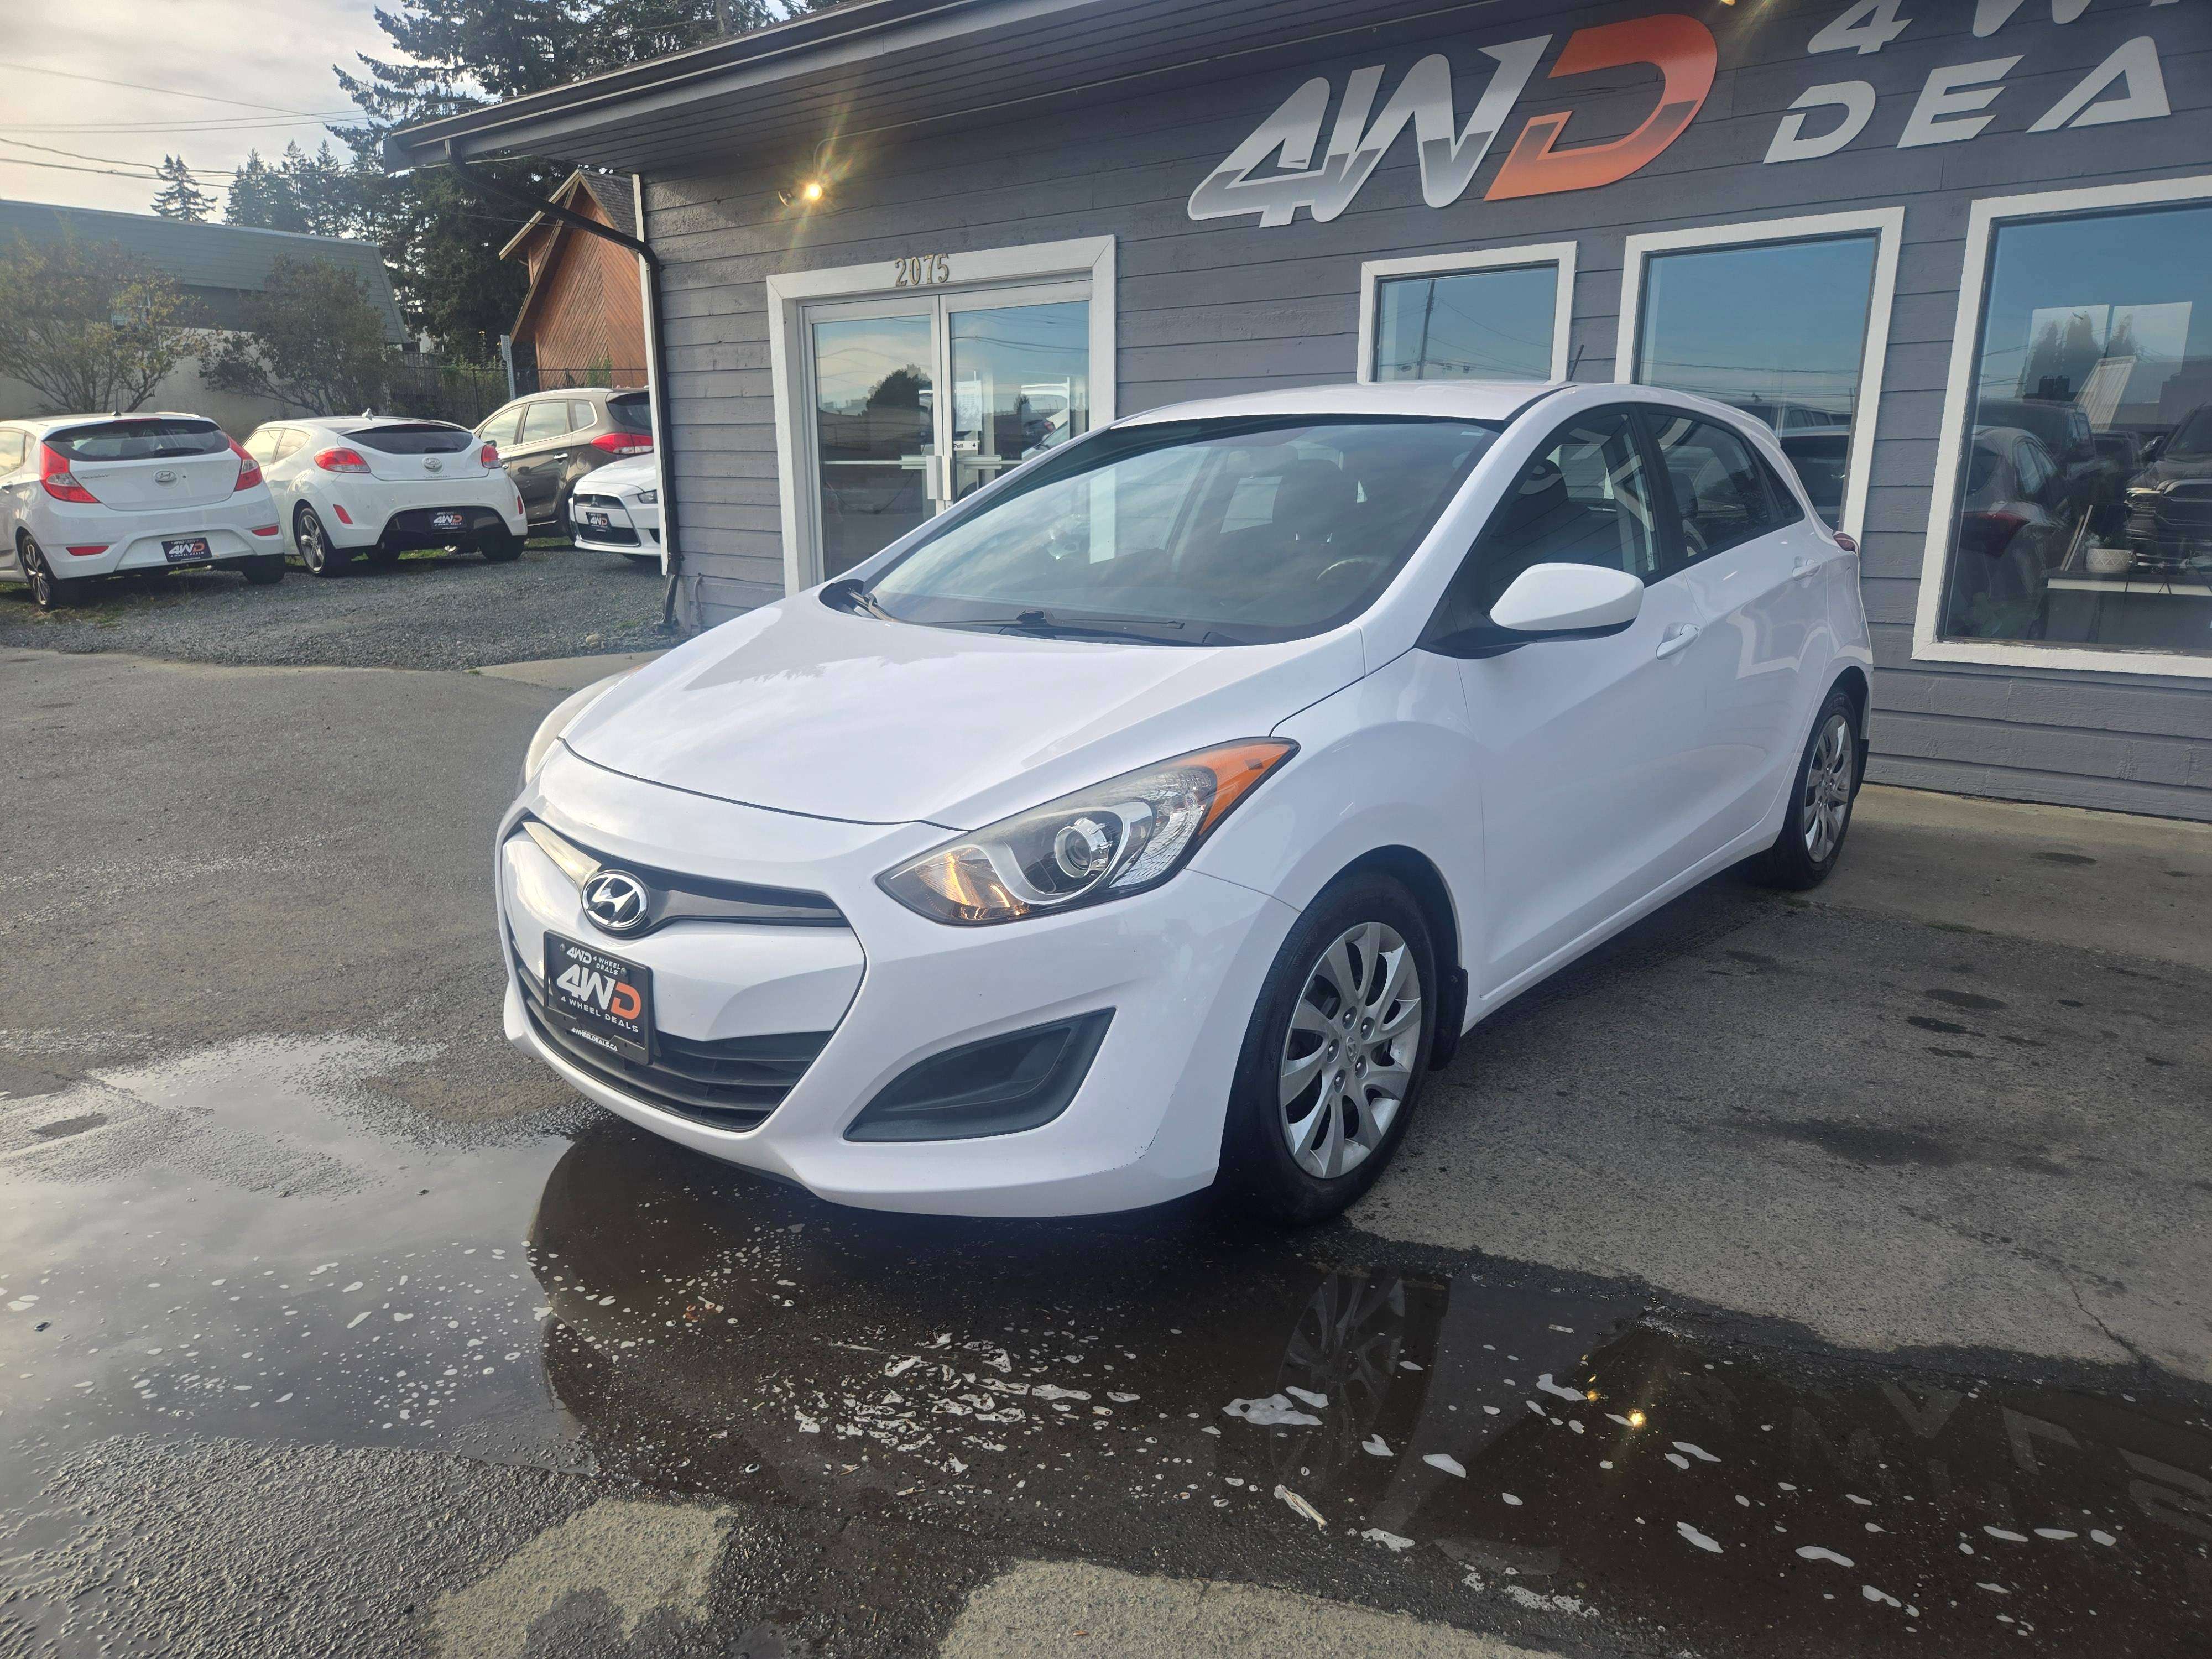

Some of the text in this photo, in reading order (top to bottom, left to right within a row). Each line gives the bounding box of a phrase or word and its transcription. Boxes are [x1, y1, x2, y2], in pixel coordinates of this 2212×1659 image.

[1807, 0, 1913, 55] 4
[1763, 36, 2171, 165] DEA
[1187, 14, 1718, 228] 4WD
[894, 253, 950, 287] 2075
[168, 543, 205, 554] 4WD
[566, 946, 592, 964] 4WD
[596, 963, 618, 975] DEALS
[599, 957, 620, 970] WHEEL
[556, 964, 641, 1020] 4WD
[569, 998, 601, 1017] WHEEL
[604, 1014, 639, 1033] DEALS
